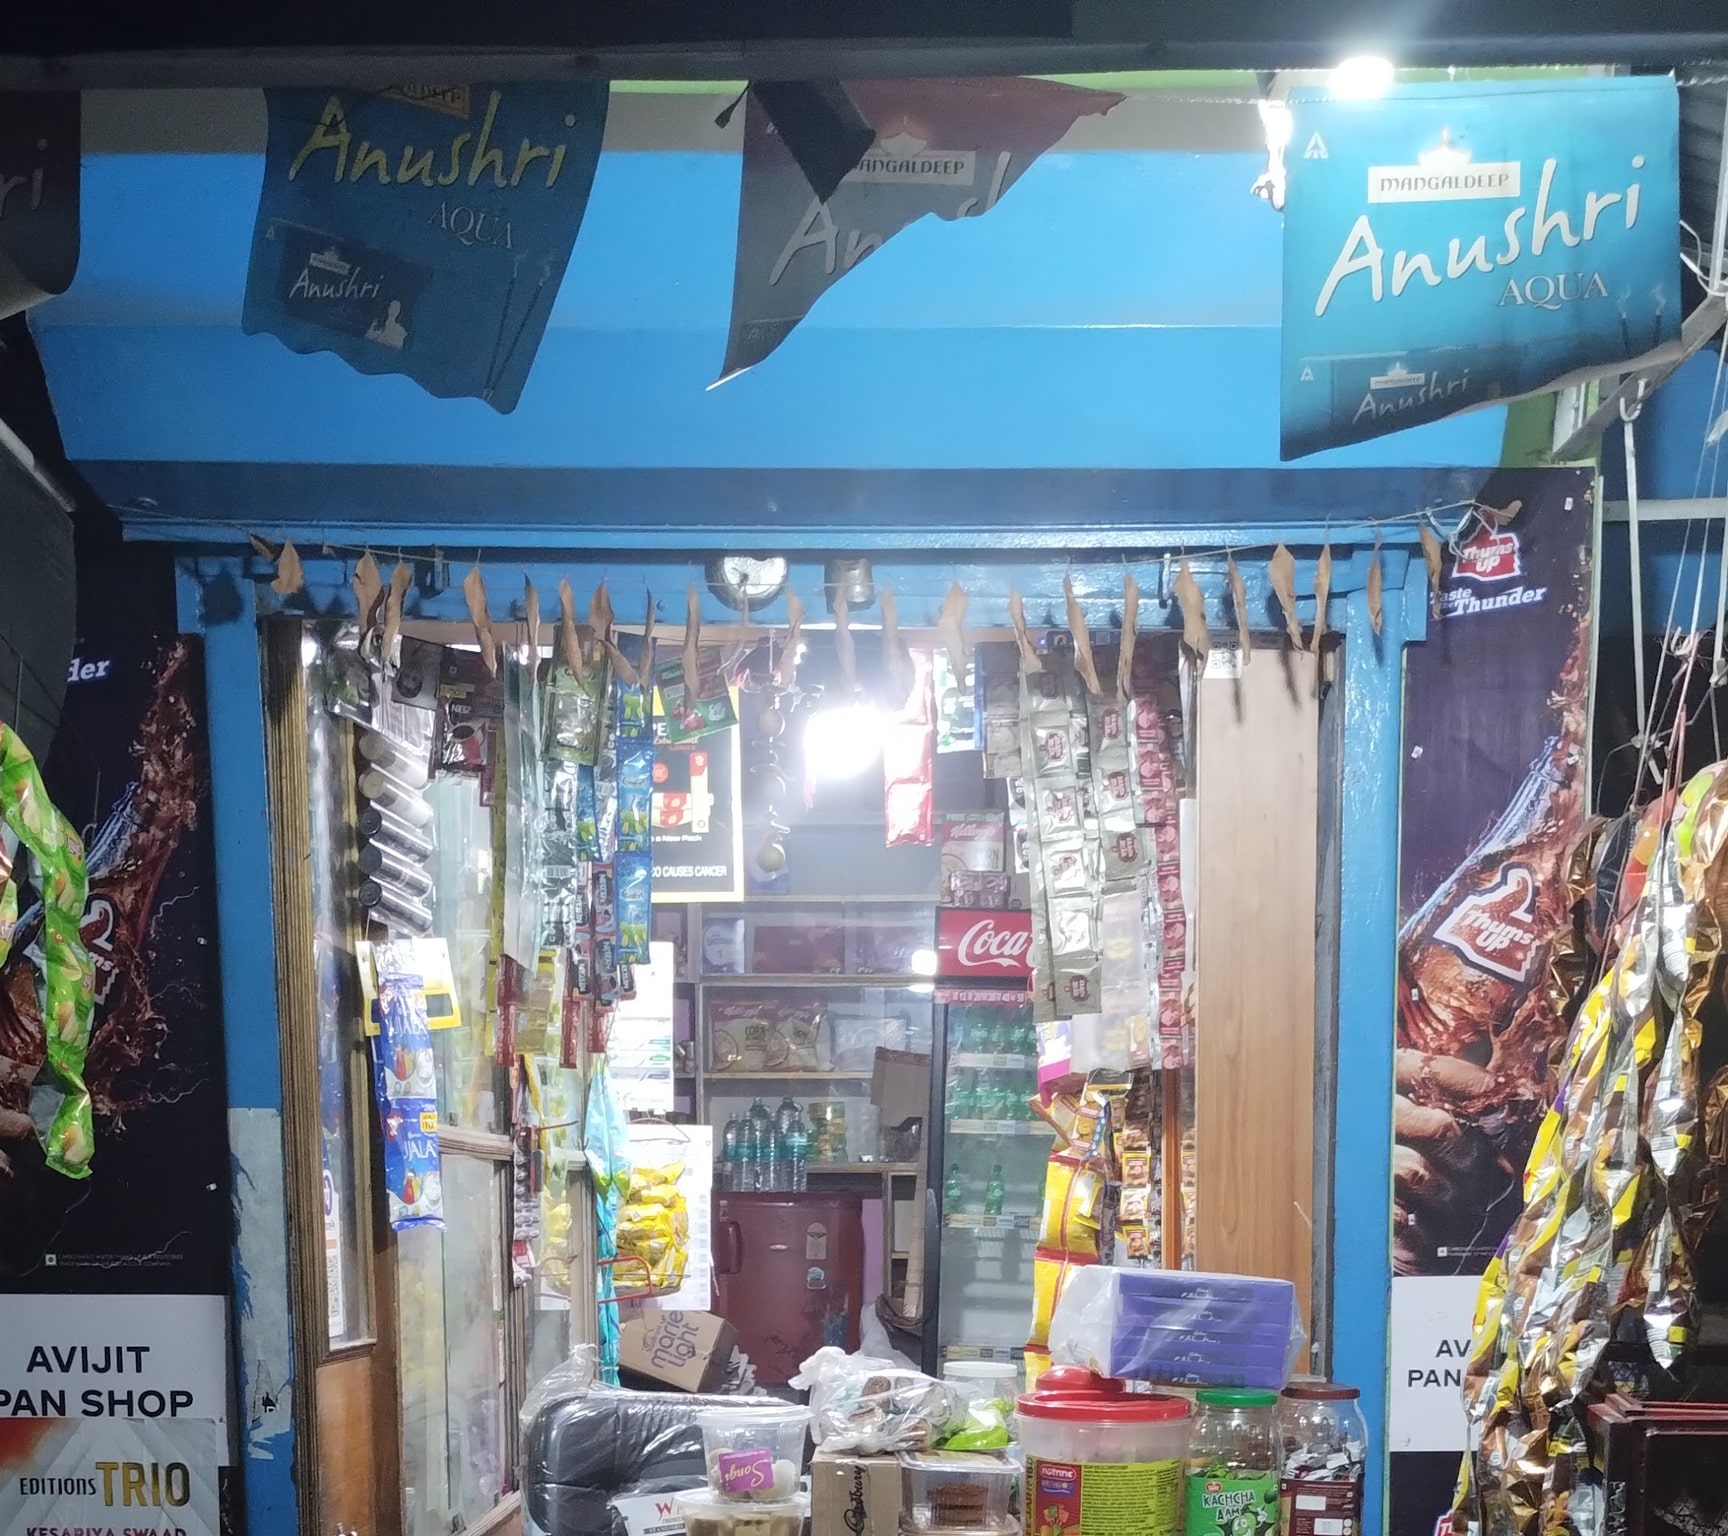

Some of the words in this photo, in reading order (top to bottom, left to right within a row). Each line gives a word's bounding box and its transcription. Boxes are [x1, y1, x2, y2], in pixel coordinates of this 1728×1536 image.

[288, 90, 576, 188] Anushri
[853, 158, 965, 177] ANGALDEEP
[1379, 173, 1510, 192] MANGALDEEP
[428, 201, 515, 249] AQUA
[1314, 154, 1645, 318] Anushri
[289, 267, 385, 299] Anushri
[1498, 272, 1608, 311] AQUA
[1352, 367, 1470, 425] Anushri
[1452, 586, 1548, 616] Thunder
[26, 1345, 151, 1374] AVIJIT
[81, 1389, 195, 1418] SHOP
[96, 1461, 191, 1508] TRIO
[1202, 1490, 1256, 1508] KACHCHA
[1216, 1507, 1241, 1521] AAM
